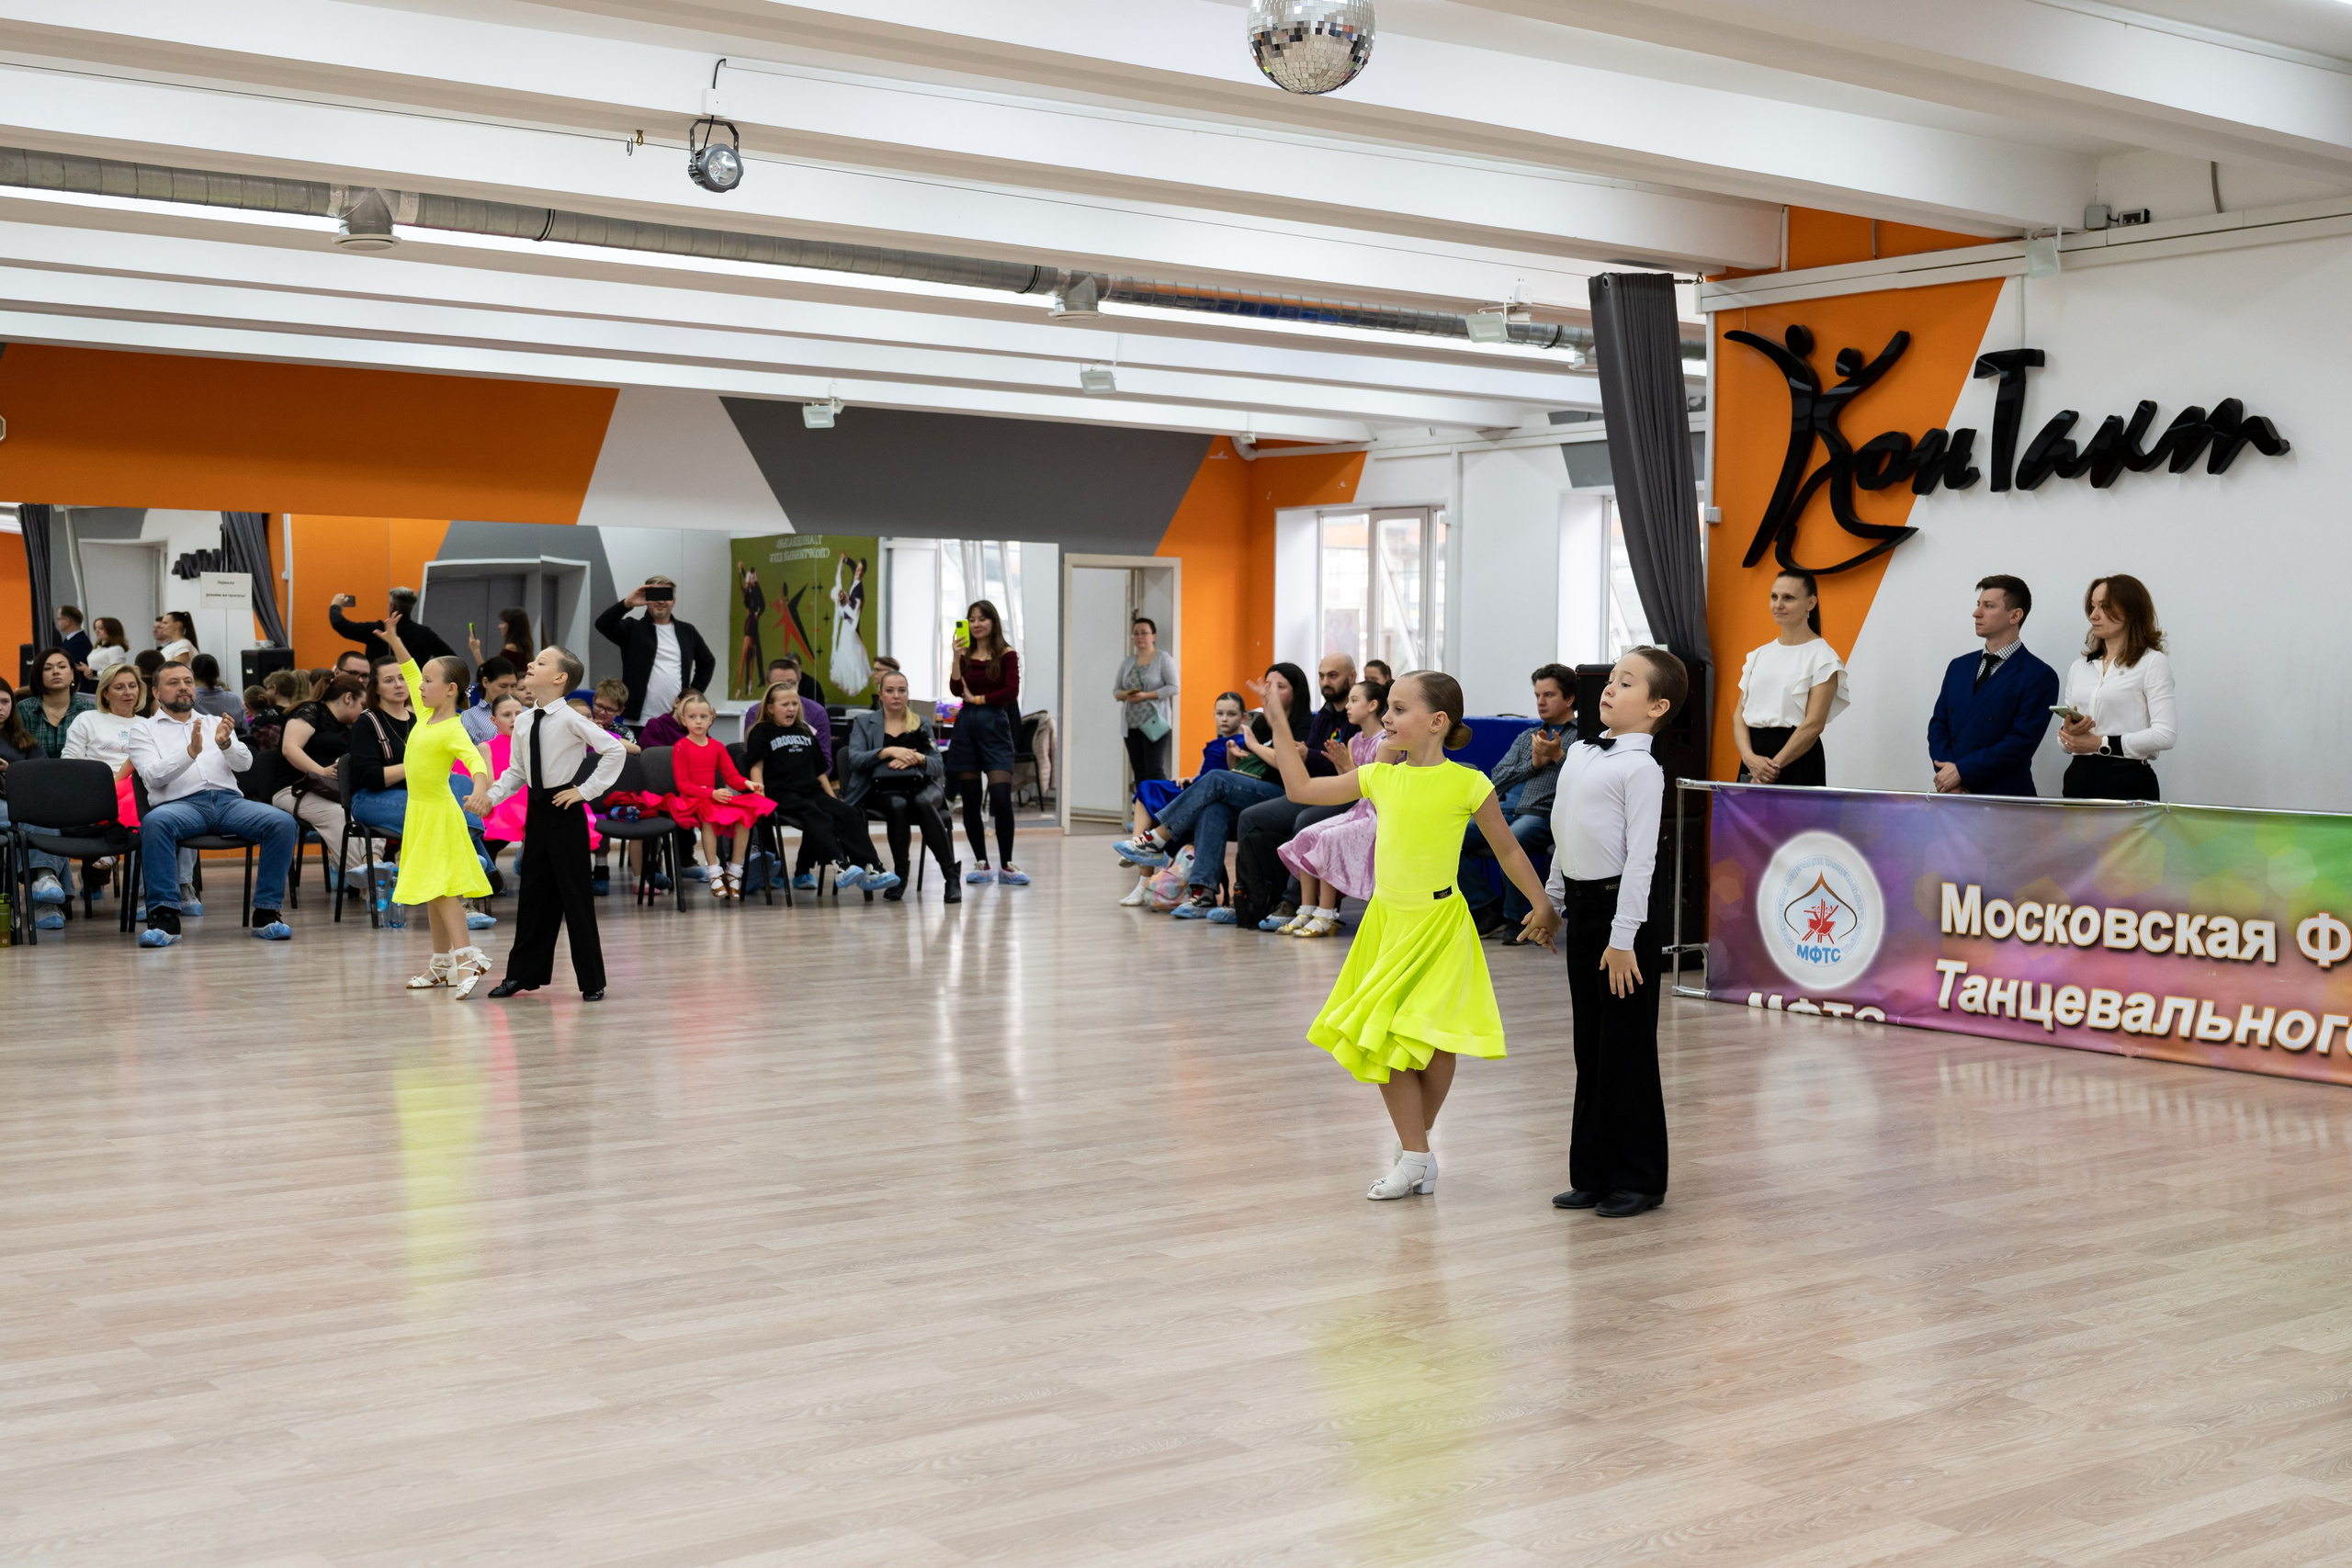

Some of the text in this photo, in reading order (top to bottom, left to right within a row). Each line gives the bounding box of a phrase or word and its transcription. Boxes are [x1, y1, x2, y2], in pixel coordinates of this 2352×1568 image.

[1796, 943, 1841, 964] МФТС
[1940, 882, 2277, 964] Московская
[1935, 958, 2352, 1056] Танцевальног
